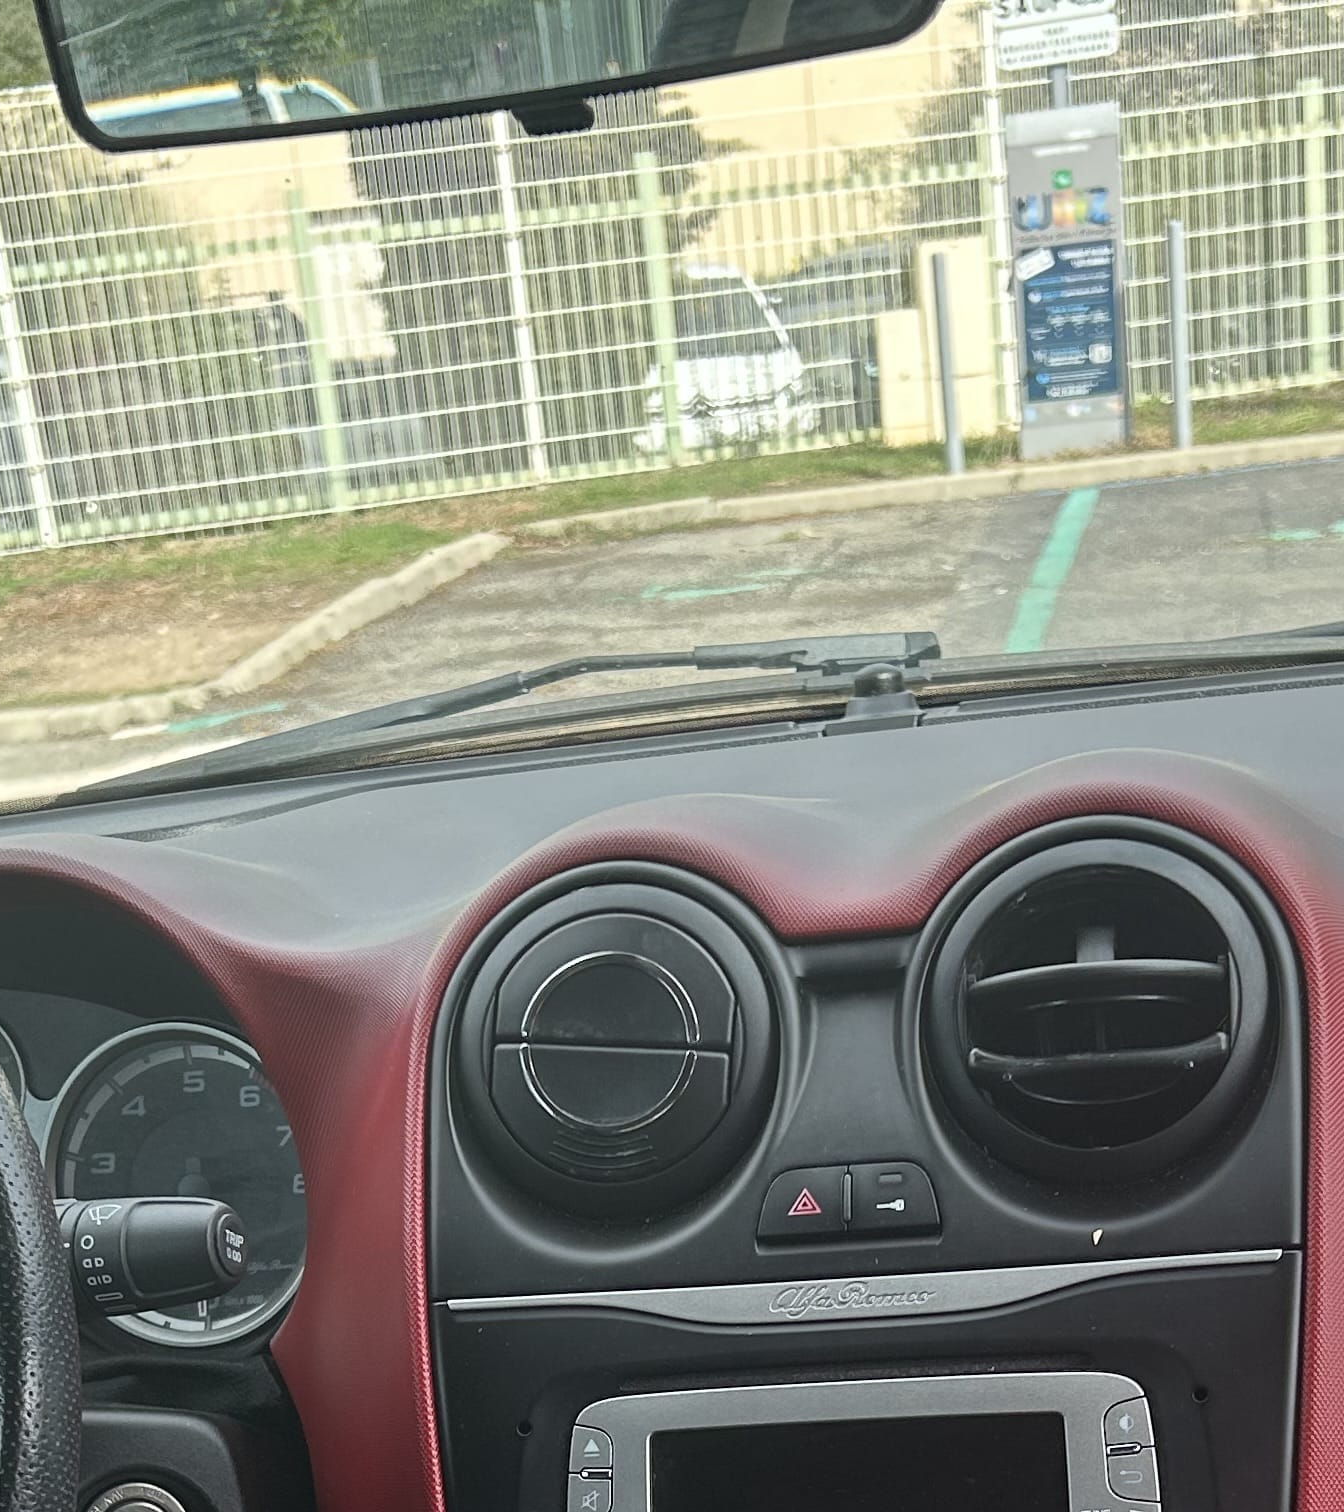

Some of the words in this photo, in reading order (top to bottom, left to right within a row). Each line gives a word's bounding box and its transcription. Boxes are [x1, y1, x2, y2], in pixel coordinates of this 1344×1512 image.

[182, 1070, 206, 1093] 5
[121, 1095, 146, 1117] 4
[239, 1085, 261, 1108] 6
[275, 1125, 293, 1147] 7
[89, 1153, 116, 1175] 3
[224, 1228, 245, 1249] TRIP
[768, 1284, 833, 1319] Alfa
[837, 1280, 936, 1309] Romeo
